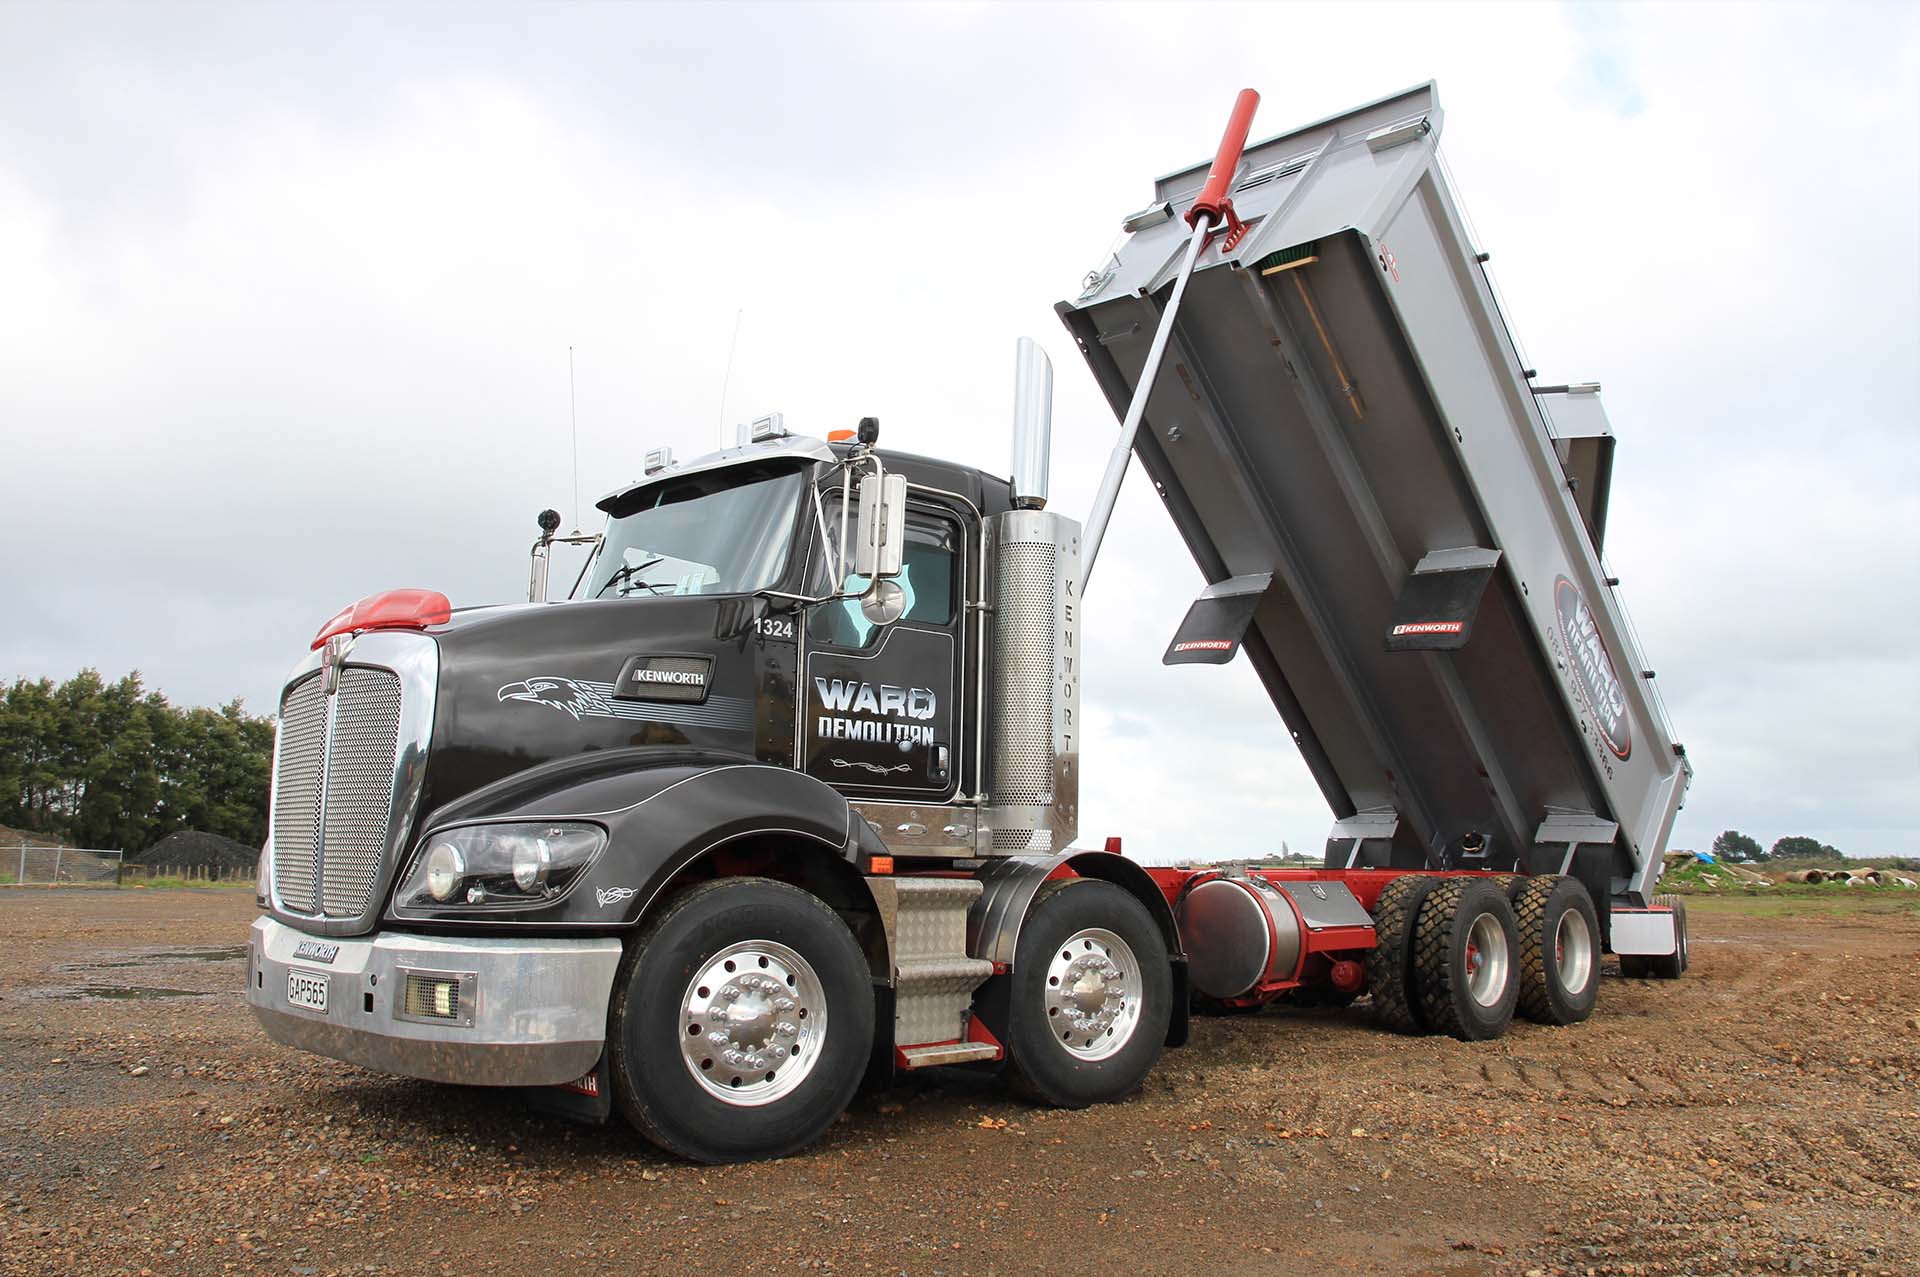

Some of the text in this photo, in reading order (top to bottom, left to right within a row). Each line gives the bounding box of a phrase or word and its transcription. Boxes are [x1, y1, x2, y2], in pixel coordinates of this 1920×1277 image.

[754, 617, 793, 638] 1324
[1405, 622, 1460, 633] KENWORTH
[1183, 640, 1230, 650] KENWORTH
[1575, 588, 1625, 718] WARD
[637, 669, 704, 685] KENWORTH
[1063, 579, 1073, 778] KENWORTH
[1567, 618, 1617, 735] DEMOLITION
[815, 676, 937, 720] WARD
[818, 716, 935, 747] DEMOLITION
[297, 940, 339, 961] KENWORTH
[289, 977, 325, 1005] GAP565
